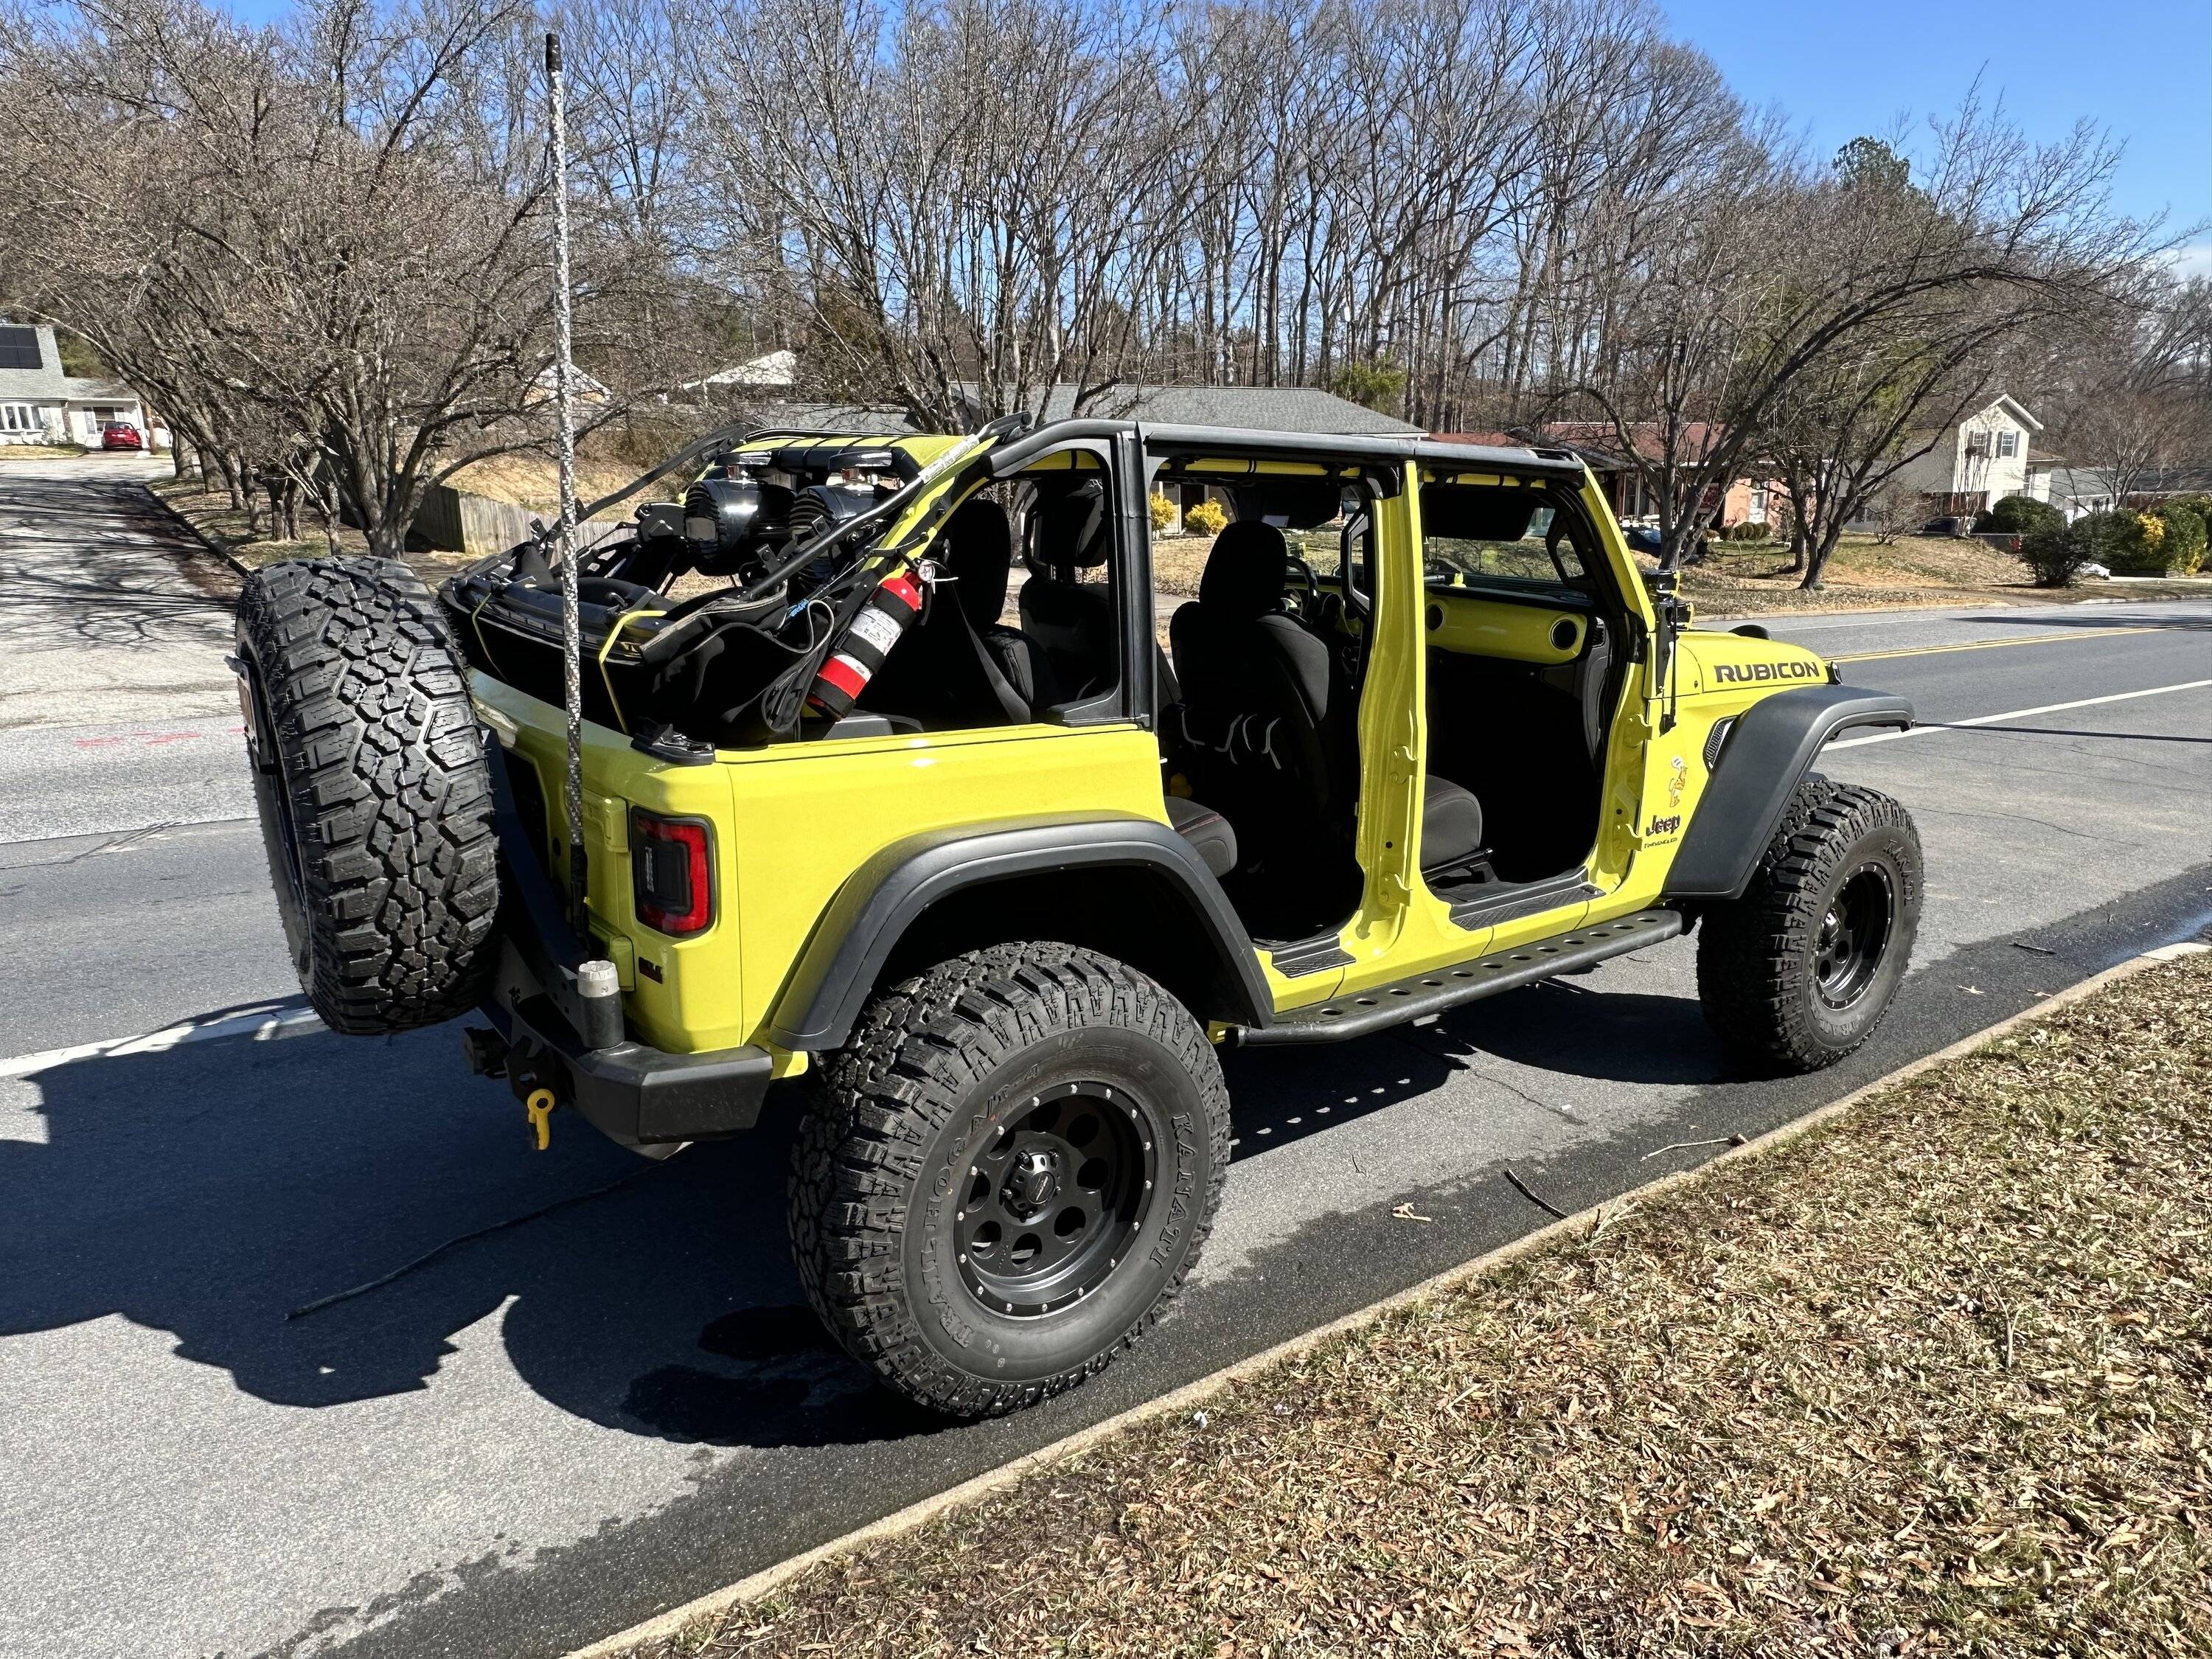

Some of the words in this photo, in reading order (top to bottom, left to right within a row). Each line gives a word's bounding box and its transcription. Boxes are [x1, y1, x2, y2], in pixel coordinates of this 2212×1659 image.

[1714, 661, 1820, 683] RUBICON
[1646, 815, 1680, 836] Jeep
[924, 1137, 966, 1231] HOG
[1149, 1112, 1198, 1269] KANATI
[921, 1238, 975, 1349] TRAIL
